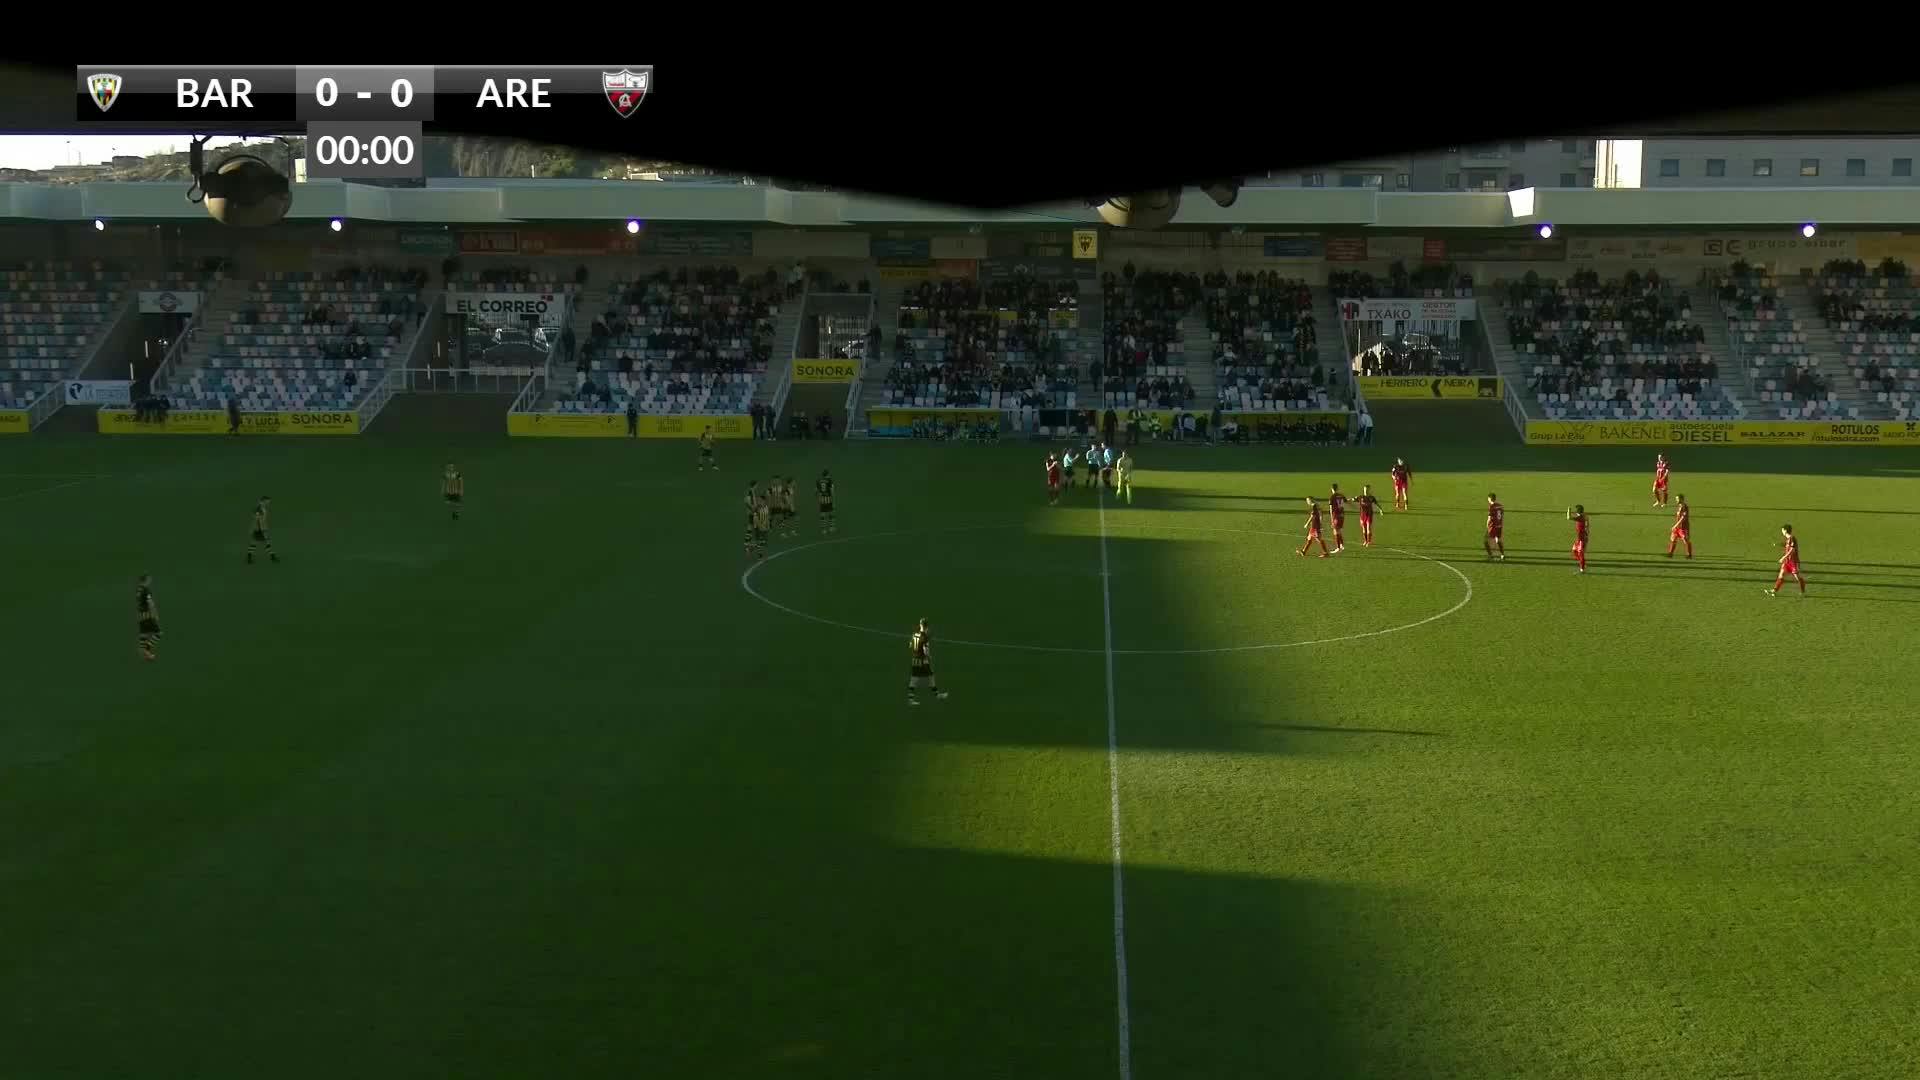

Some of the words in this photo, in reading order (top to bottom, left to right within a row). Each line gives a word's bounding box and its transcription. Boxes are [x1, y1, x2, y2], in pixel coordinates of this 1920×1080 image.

[456, 299, 477, 313] EL
[479, 300, 548, 313] CORREO
[1367, 309, 1412, 320] TXAKO
[796, 365, 855, 376] SONORA
[291, 414, 353, 424] SONORA
[1670, 422, 1735, 431] autoescuela
[1530, 432, 1553, 441] Grup
[1671, 430, 1734, 442] DIESEL
